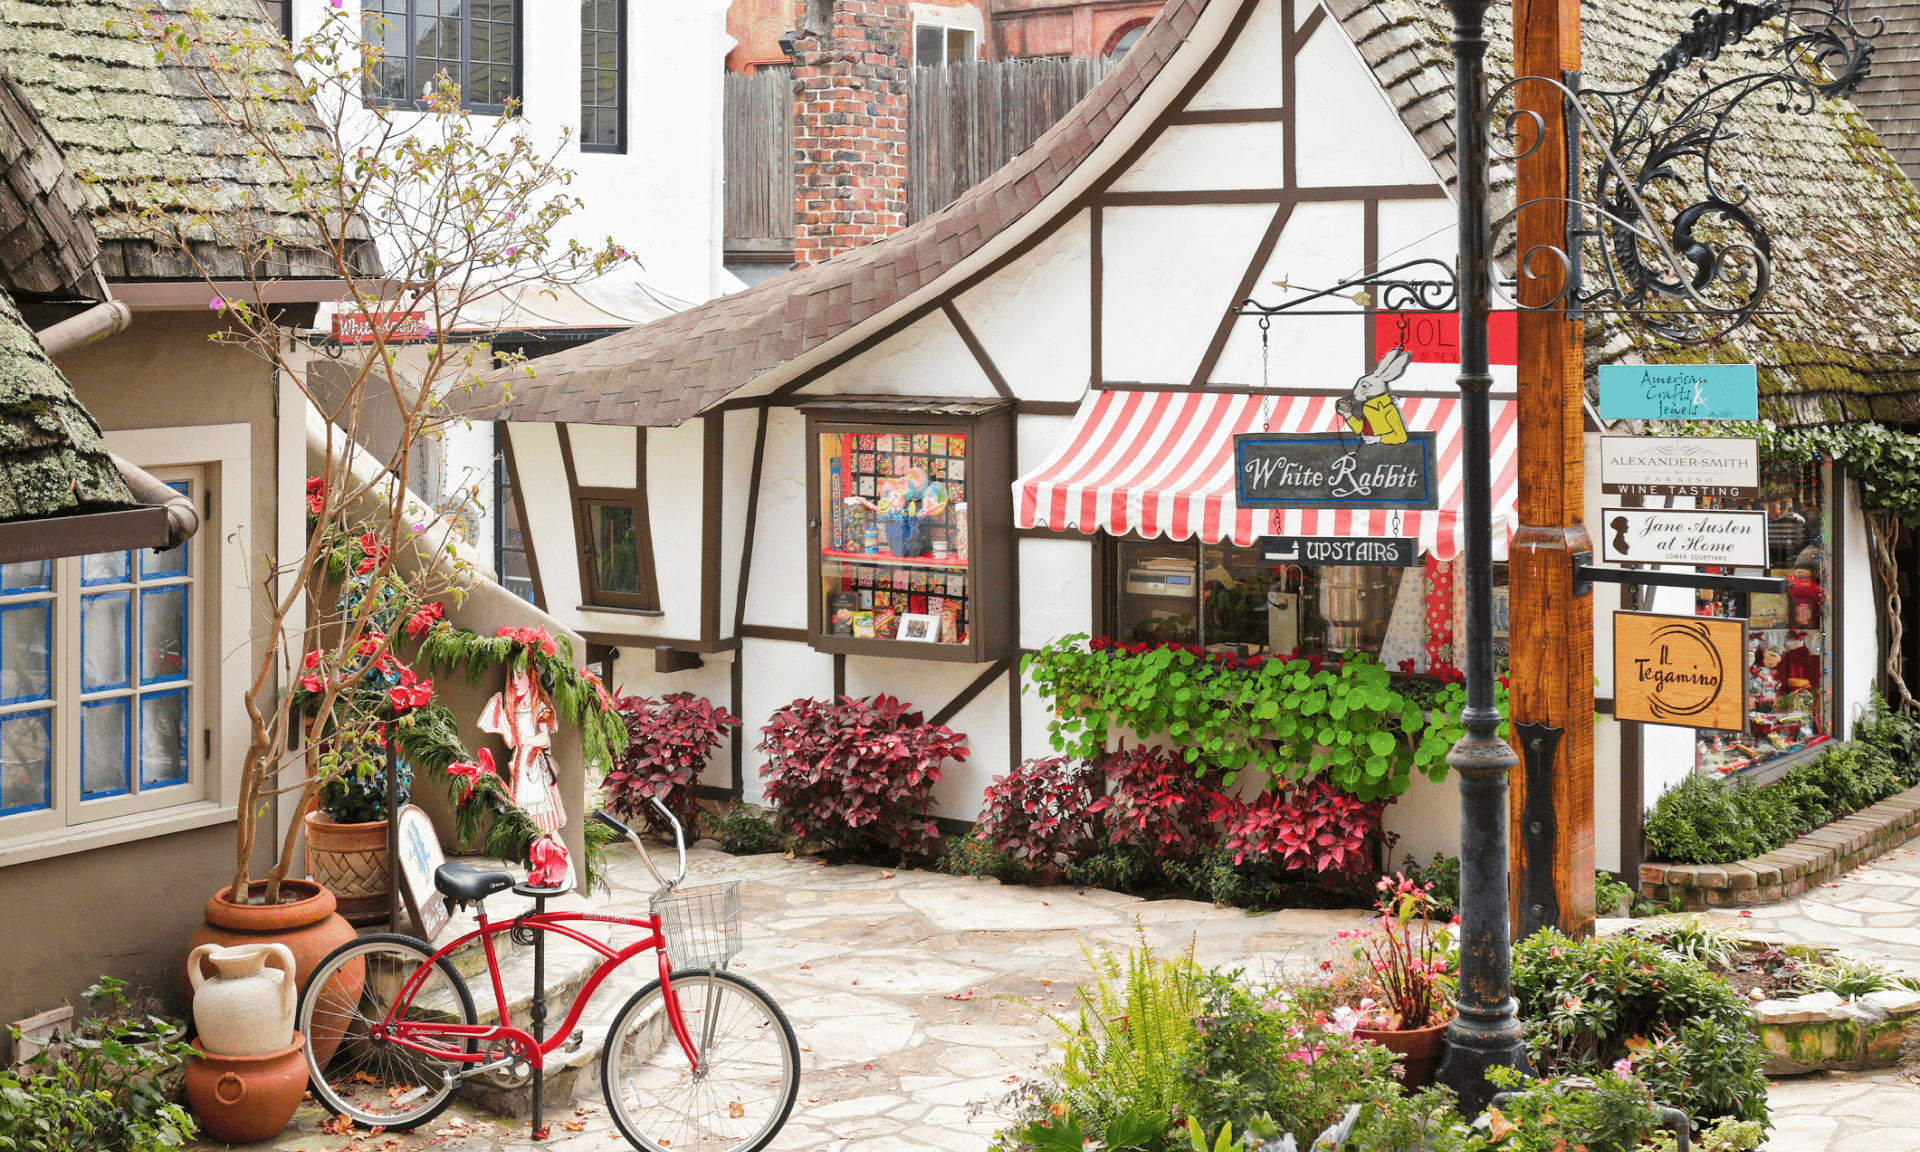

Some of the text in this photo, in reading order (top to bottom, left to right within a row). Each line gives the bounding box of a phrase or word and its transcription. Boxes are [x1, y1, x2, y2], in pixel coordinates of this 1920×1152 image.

[1394, 318, 1455, 347] JOL
[1640, 370, 1709, 386] American
[1646, 379, 1711, 411] Crafts &
[1656, 399, 1698, 419] Jewels
[1245, 453, 1419, 497] White Rabbit
[1645, 476, 1713, 484] PARAISO
[1618, 485, 1740, 497] WINE TASTING
[1639, 516, 1752, 537] Jane Austen
[1306, 541, 1399, 562] UPSTAIRS
[1656, 535, 1735, 553] at Home
[1634, 658, 1718, 693] Tegamino
